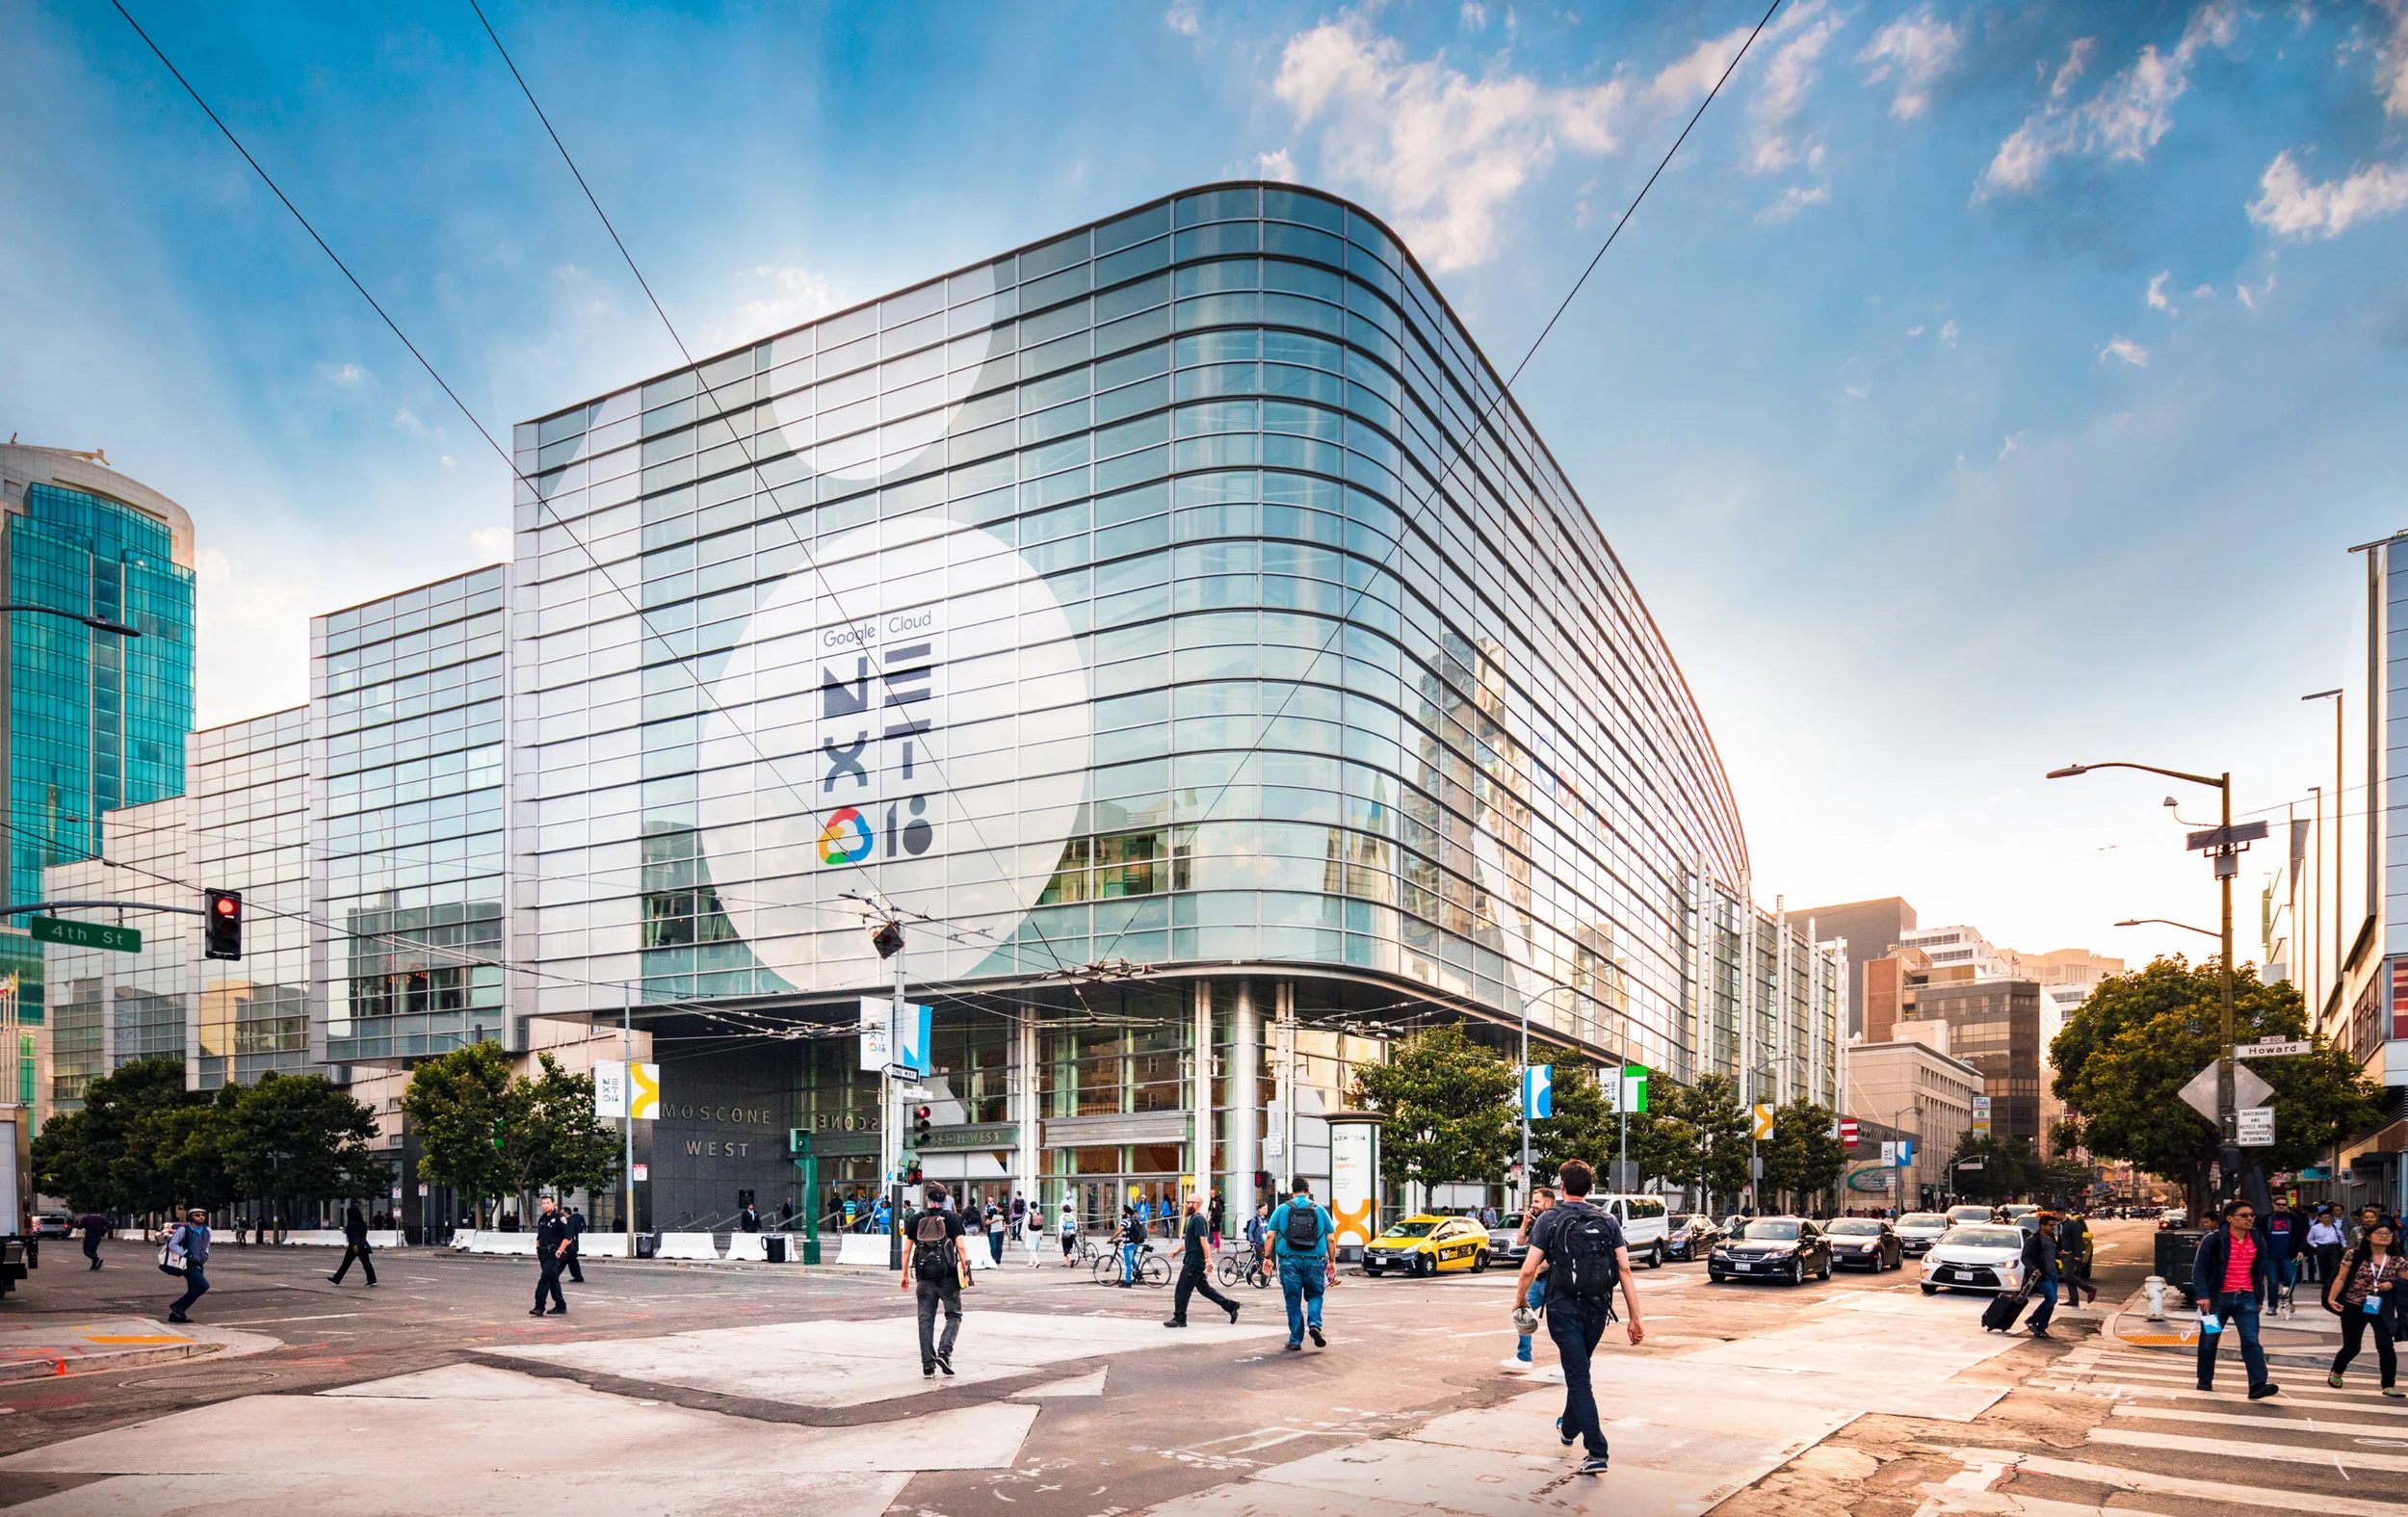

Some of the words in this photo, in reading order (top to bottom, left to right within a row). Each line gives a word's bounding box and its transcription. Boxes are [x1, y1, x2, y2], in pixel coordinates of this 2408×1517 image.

[824, 623, 876, 647] Google
[888, 610, 932, 634] Cloud
[51, 925, 87, 941] 4th
[102, 930, 123, 946] St
[2248, 1044, 2297, 1055] Howard
[662, 1103, 772, 1125] MOSCONE
[970, 1132, 1001, 1142] WEST
[686, 1140, 748, 1157] WEST
